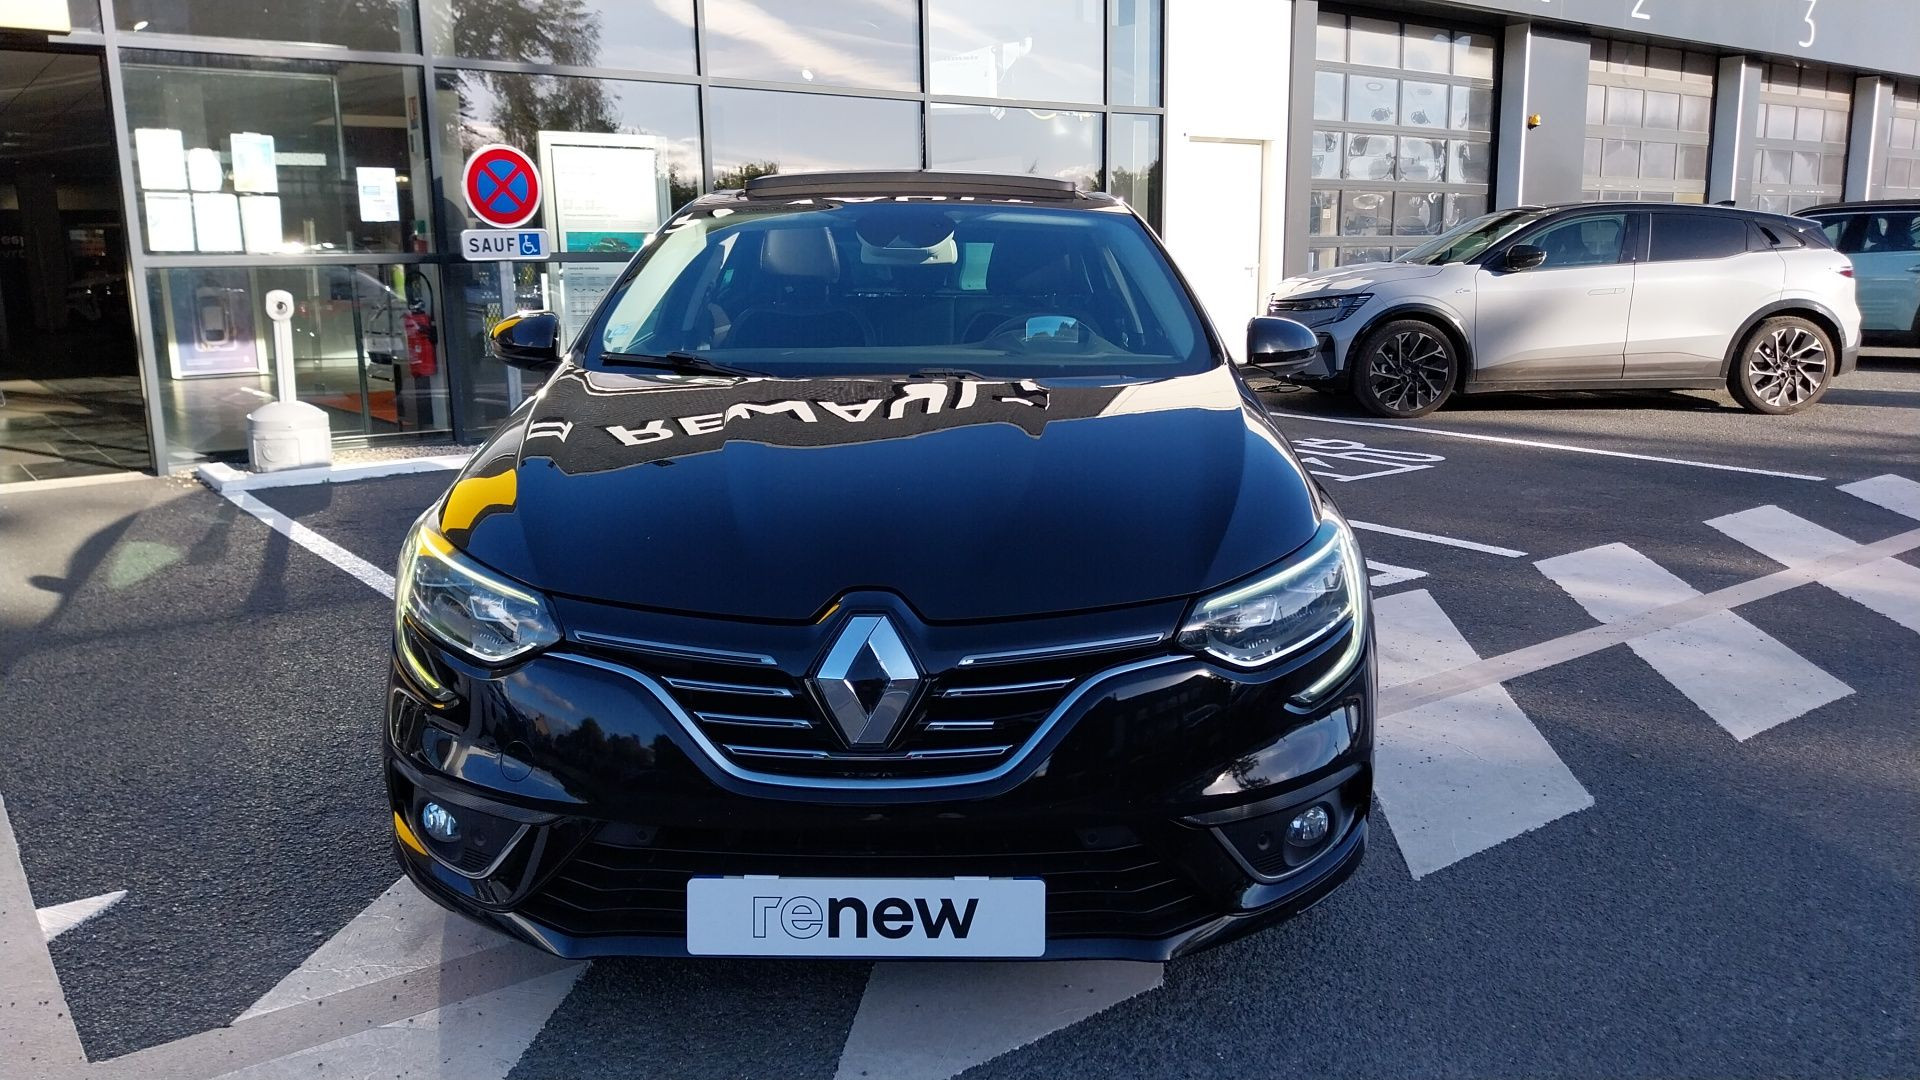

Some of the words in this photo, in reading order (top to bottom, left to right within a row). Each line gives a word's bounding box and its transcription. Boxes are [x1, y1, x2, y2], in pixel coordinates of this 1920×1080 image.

[1798, 0, 1816, 48] 3
[469, 237, 515, 253] SAUF
[753, 896, 979, 939] renew
